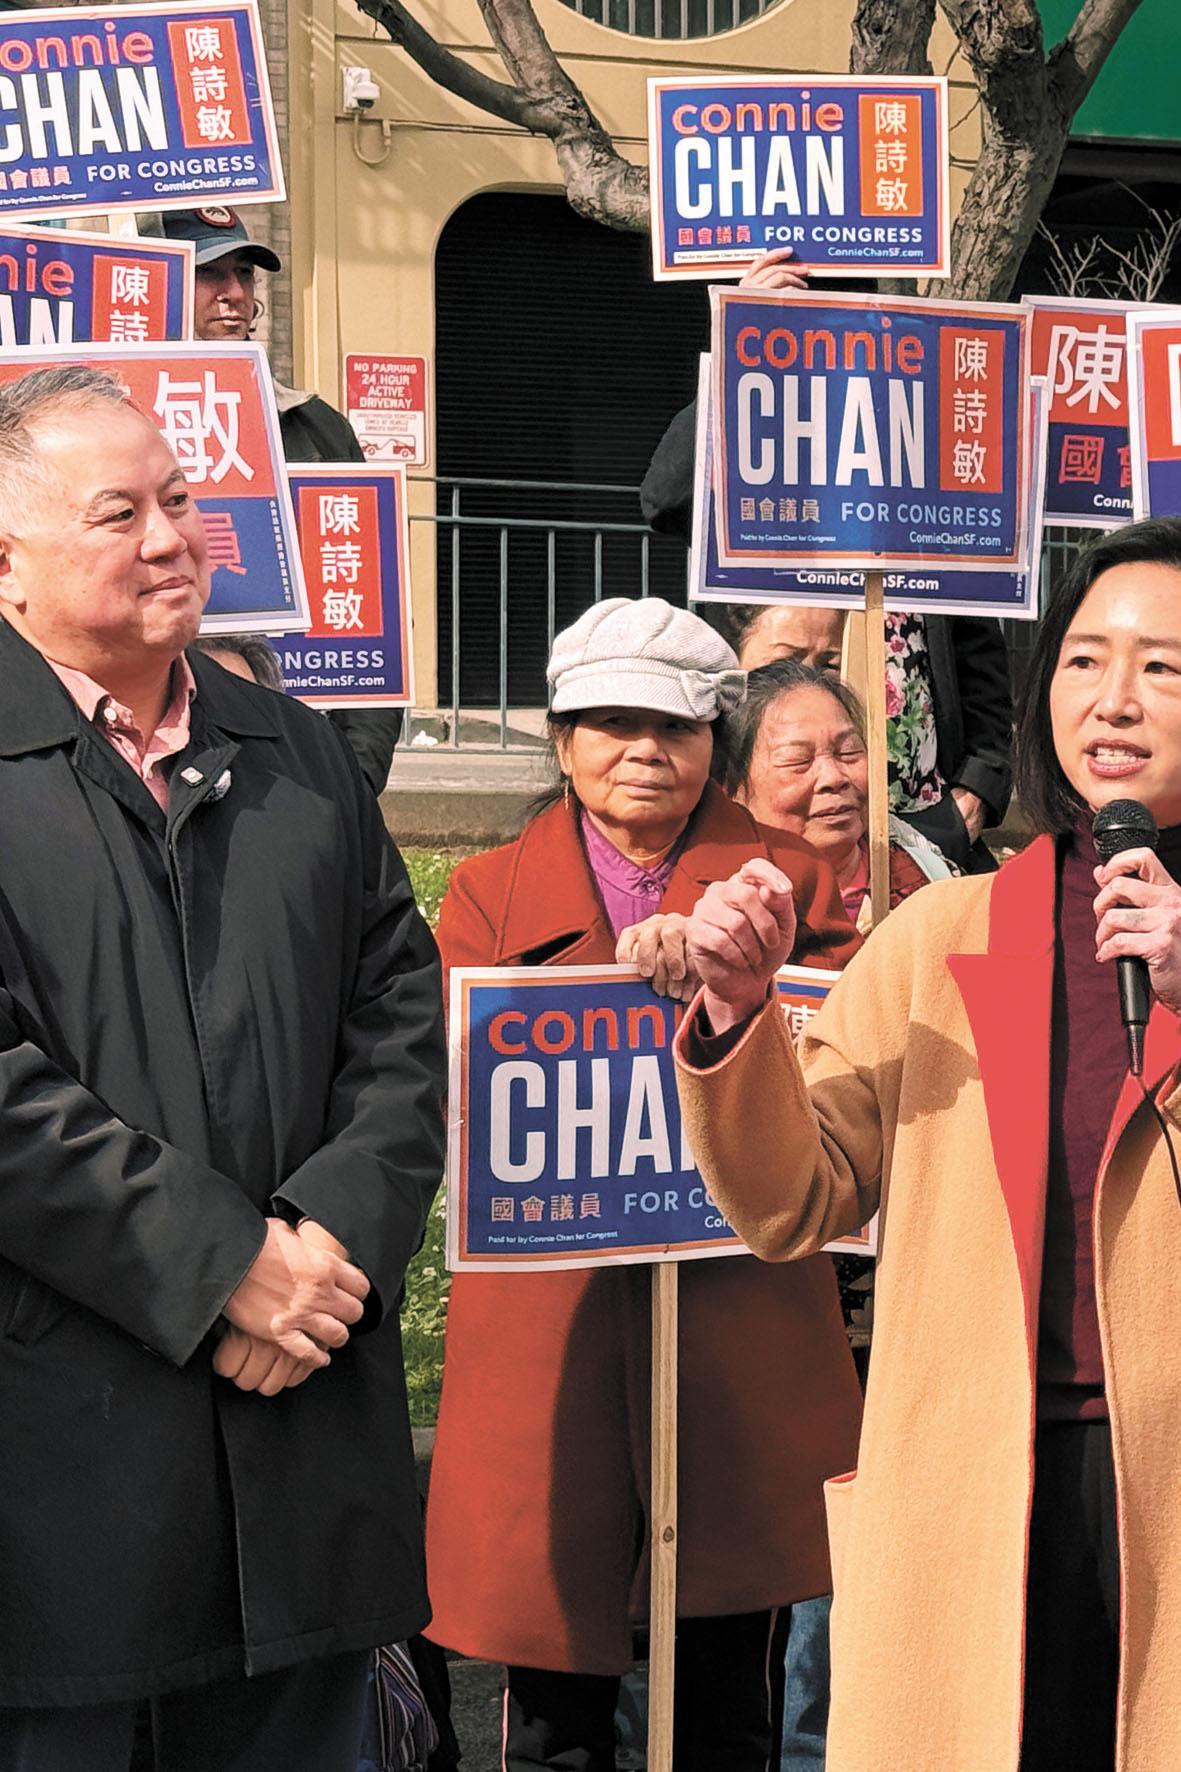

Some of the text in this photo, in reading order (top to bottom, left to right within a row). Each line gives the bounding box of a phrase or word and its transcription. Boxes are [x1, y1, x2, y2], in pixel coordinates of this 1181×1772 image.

[0, 21, 154, 72] onnie
[184, 26, 236, 142] 陳詩敏
[672, 90, 844, 135] connie
[86, 155, 256, 182] FOR CONGRESS
[874, 101, 908, 212] 陳詩敏
[154, 176, 258, 193] ConnieChanSF.com
[674, 135, 845, 220] CHAN
[677, 225, 751, 247] 國會議員
[764, 226, 923, 244] FOR CONGRESS
[827, 246, 924, 258] ConnieChanSF.com
[109, 265, 151, 343] 陳詩
[736, 317, 925, 374] connie
[353, 362, 417, 374] NO PARKING
[361, 374, 410, 386] 24 HOUR
[360, 397, 412, 409] DRIVEWAY
[368, 386, 405, 397] ACTIVE
[952, 336, 988, 486] 陳詩敏
[736, 372, 926, 489] CHAN
[740, 497, 821, 523] 國會議員
[841, 502, 1002, 528] FOR CONGRESS
[909, 530, 1002, 547] ConnieChanSF.com
[318, 494, 364, 631] 陳詩敏
[796, 570, 940, 590] ConnieChSF.com
[274, 650, 385, 670] NGRESS
[282, 675, 385, 688] nnieChanSF.com
[488, 1003, 685, 1056] conn
[491, 1193, 602, 1222] 國會議員
[624, 1190, 680, 1214] FOR
